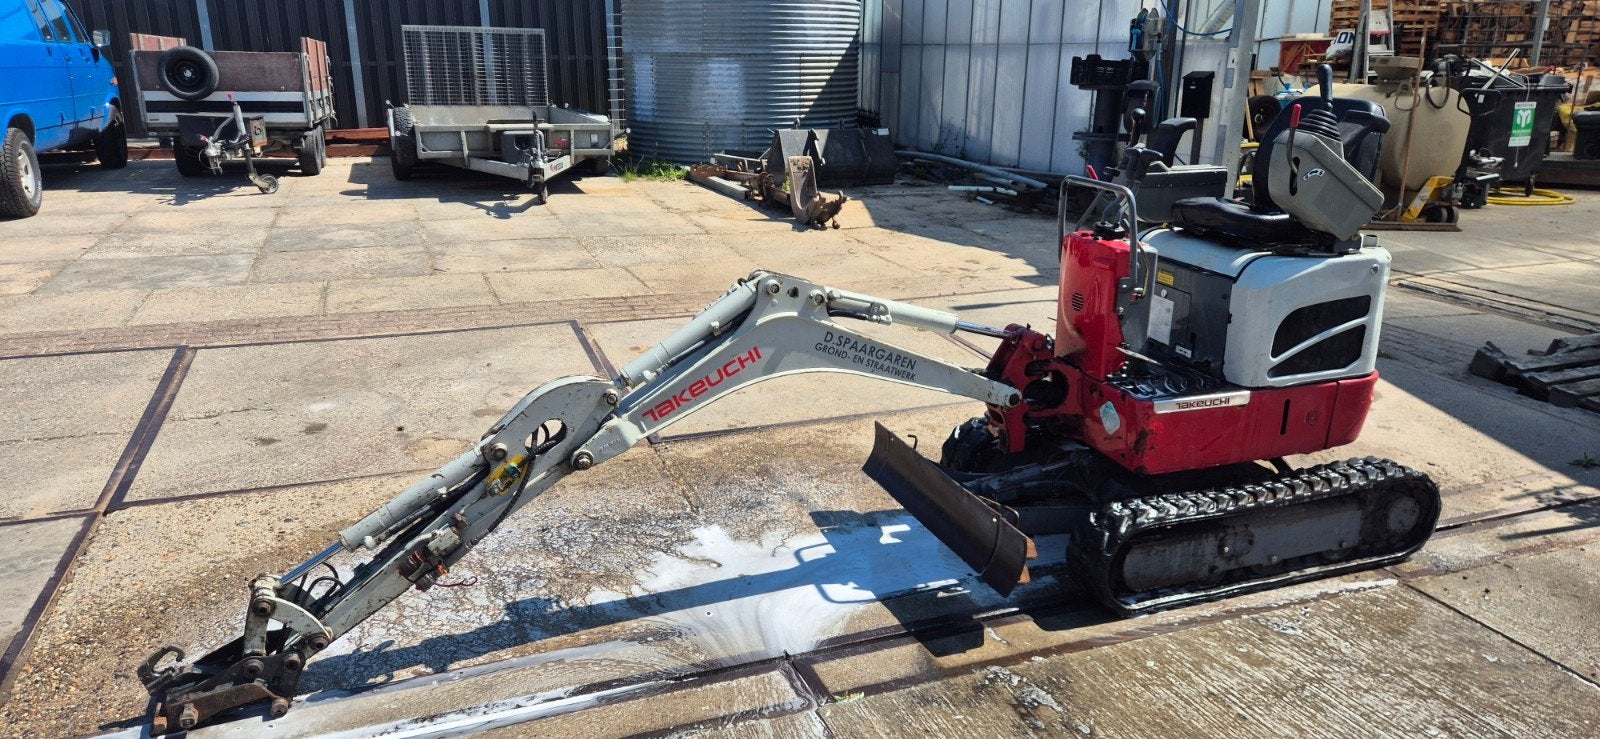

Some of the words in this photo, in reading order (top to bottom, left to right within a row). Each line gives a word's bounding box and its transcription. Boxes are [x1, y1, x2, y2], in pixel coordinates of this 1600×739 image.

[815, 342, 850, 359] GROND-
[853, 354, 865, 364] EN
[865, 358, 917, 381] STRAATWERK
